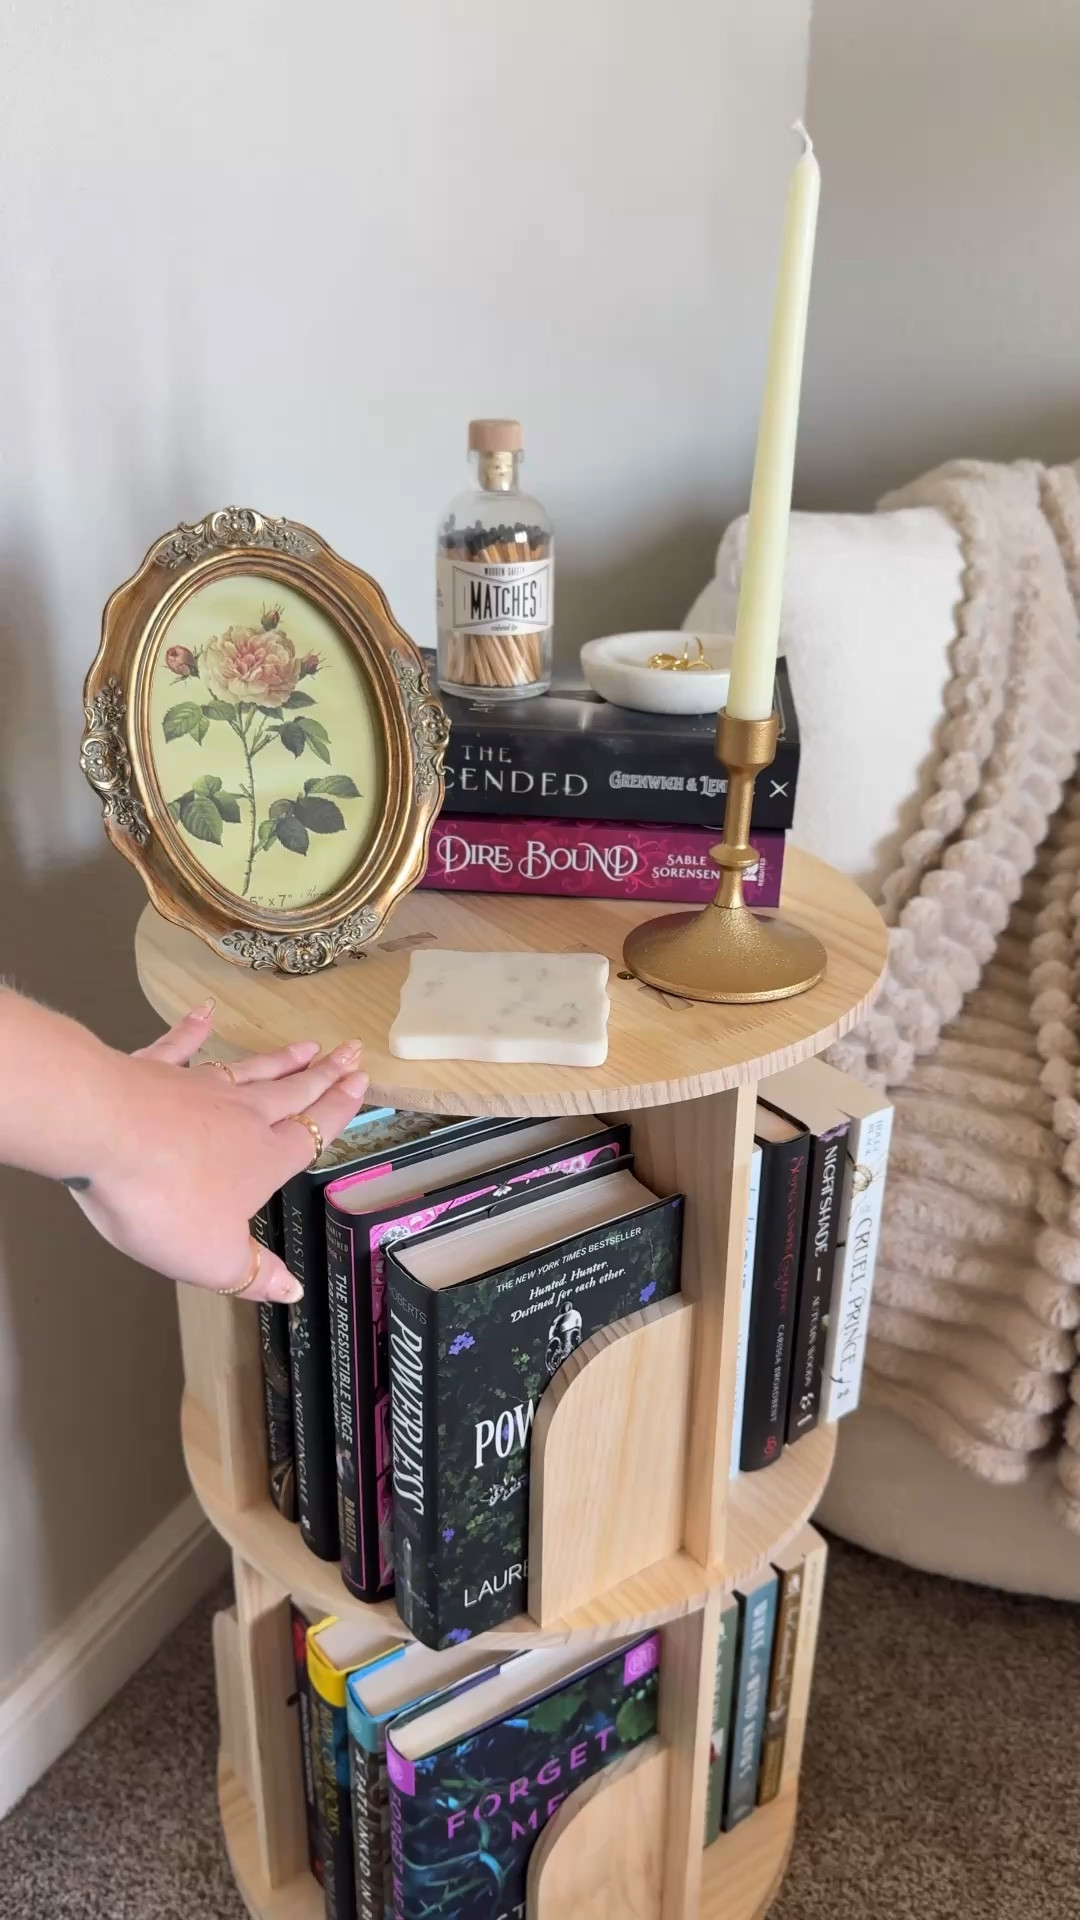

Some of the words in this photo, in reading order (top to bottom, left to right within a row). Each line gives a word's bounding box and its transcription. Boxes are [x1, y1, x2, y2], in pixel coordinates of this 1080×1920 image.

[470, 580, 537, 620] MATCHES
[461, 745, 512, 764] THE
[437, 835, 513, 874] DIRE
[517, 840, 638, 882] BOUND
[651, 866, 721, 880] SORENSEN
[666, 854, 708, 867] SABLE
[757, 857, 767, 887] REQUITED
[814, 1145, 839, 1258] NIGHTSHADE
[291, 1206, 306, 1288] KRISTI
[496, 1281, 514, 1293] THE
[515, 1271, 536, 1285] NEW
[537, 1259, 560, 1275] YORK
[562, 1247, 587, 1264] TIMES
[588, 1227, 642, 1253] BESTSELLER
[848, 1217, 873, 1292] CRUEL
[336, 1273, 348, 1304] THE
[510, 1296, 554, 1323] Destined
[555, 1288, 573, 1307] for
[575, 1278, 596, 1294] each
[599, 1267, 626, 1285] other.
[529, 1273, 567, 1300] Hunted.
[570, 1260, 609, 1282] Hunter.
[336, 1303, 352, 1402] IRRESISTIBLE
[774, 1324, 785, 1365] CARISSA
[839, 1287, 867, 1373] PRINCE
[390, 1308, 425, 1516] POWERLESS
[769, 1365, 782, 1423] BROADBENT
[340, 1401, 353, 1445] URGE
[355, 1771, 369, 1817] FATE
[447, 1725, 615, 1840] FORGET
[390, 1788, 404, 1876] FORGET
[361, 1879, 373, 1904] IN
